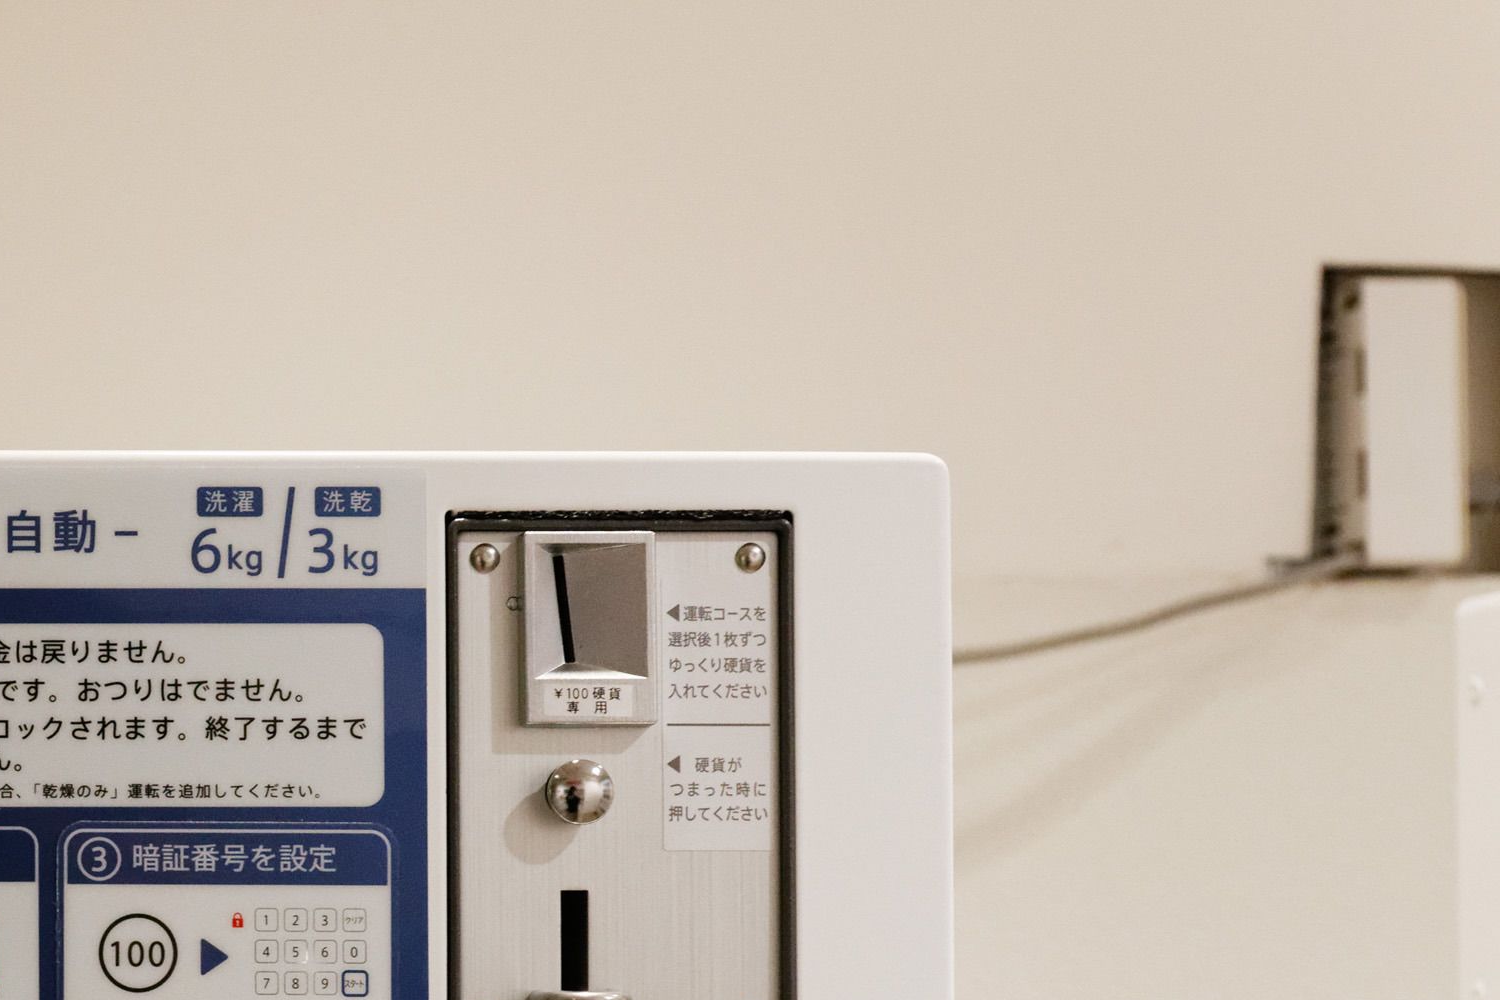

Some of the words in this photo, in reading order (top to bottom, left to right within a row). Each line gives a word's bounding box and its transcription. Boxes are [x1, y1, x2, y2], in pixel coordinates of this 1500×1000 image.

[204, 490, 255, 514] 洗濯
[323, 490, 373, 514] 洗乾
[683, 605, 766, 622] 運転コースを
[668, 632, 767, 647] 選択後1枚ずつ
[669, 658, 767, 674] ゆっくり硬貨を
[668, 684, 768, 699] 入れてください
[695, 757, 741, 773] 硬貨が
[670, 782, 767, 797] つまった時に
[668, 806, 768, 822] 押してください
[133, 844, 336, 872] 暗証番号を設定
[263, 915, 269, 926] 1
[291, 915, 299, 926] 2
[321, 915, 329, 926] 3
[110, 941, 166, 967] 100
[262, 947, 270, 958] 4
[291, 947, 299, 958] 5
[321, 947, 329, 958] 6
[350, 947, 358, 958] 0
[262, 978, 270, 989] 7
[291, 978, 299, 989] 8
[321, 978, 329, 989] 9
